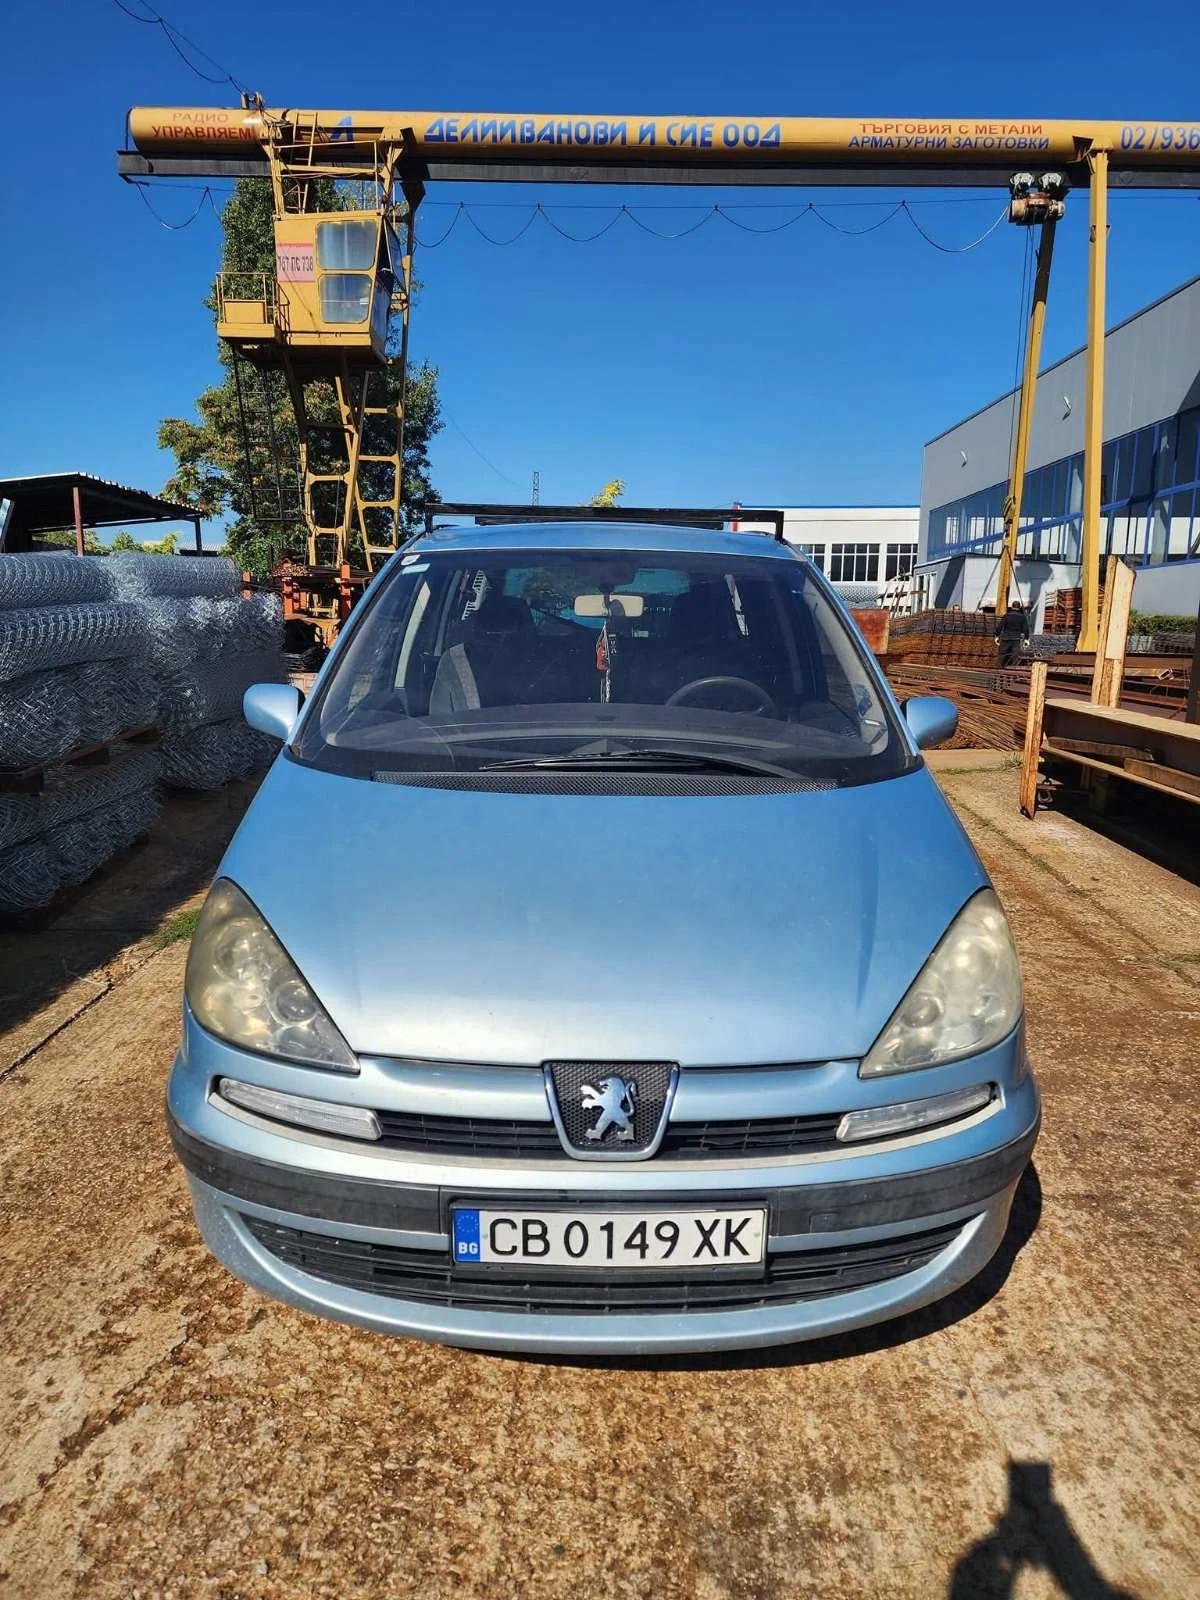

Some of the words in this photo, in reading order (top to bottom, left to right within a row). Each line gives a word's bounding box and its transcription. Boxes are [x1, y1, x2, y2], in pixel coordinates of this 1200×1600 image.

[172, 112, 229, 123] РАДИО
[638, 121, 656, 146] И
[666, 122, 714, 147] СИЕ
[722, 123, 780, 148] ООД
[860, 123, 952, 135] ТЪРГОВИЯ
[958, 124, 969, 135] С
[975, 124, 1042, 135] МЕТАЛИ
[848, 135, 948, 149] АРМАТУРНИ
[951, 136, 1050, 150] ЗАГОТОВКИ
[489, 1218, 550, 1257] CB
[563, 1220, 680, 1259] 0149
[692, 1218, 752, 1258] XK
[458, 1242, 479, 1254] BG
